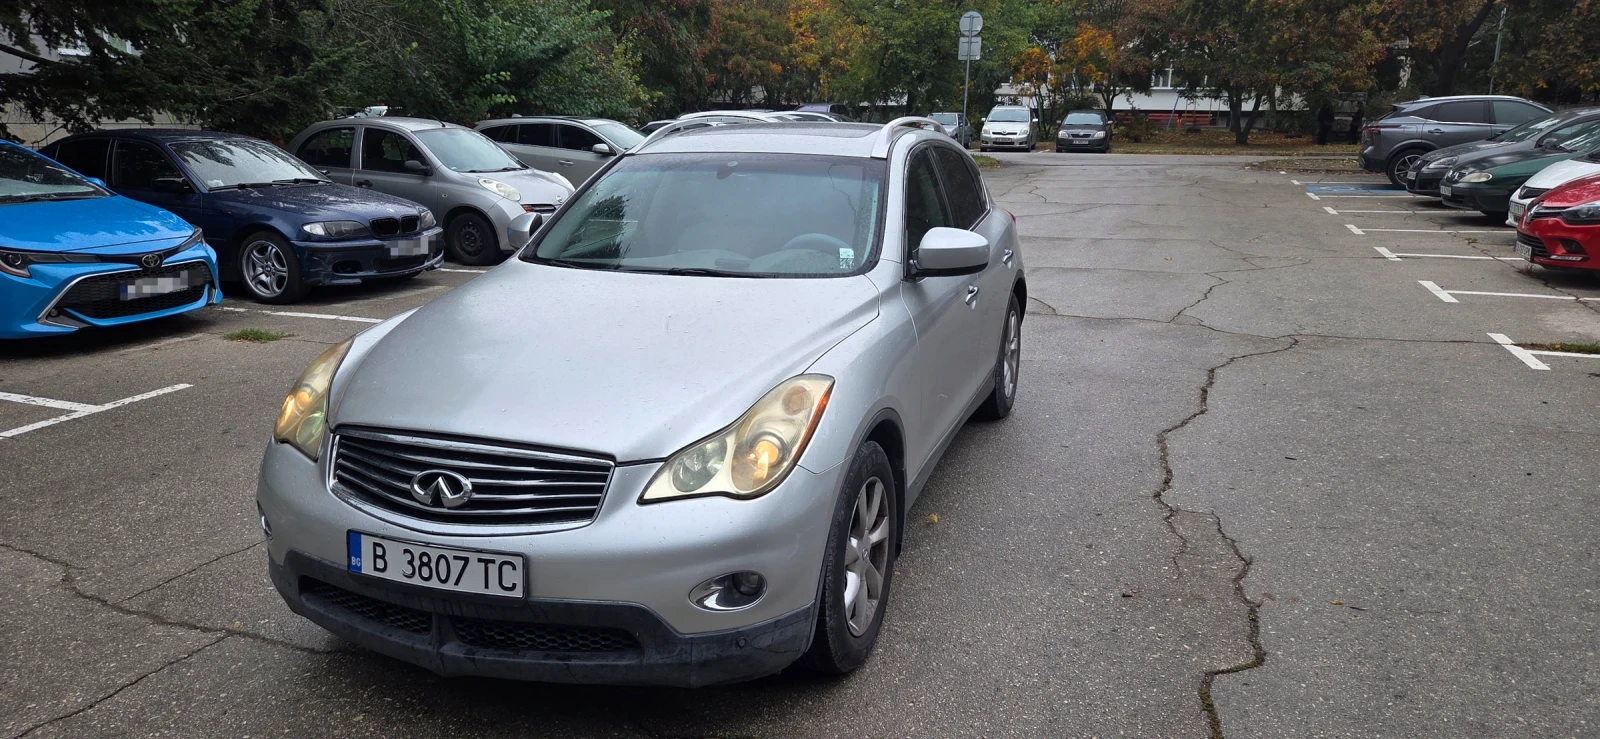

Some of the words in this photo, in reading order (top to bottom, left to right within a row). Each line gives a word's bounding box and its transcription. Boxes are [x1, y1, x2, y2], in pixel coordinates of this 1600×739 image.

[351, 556, 361, 567] BG
[372, 541, 388, 573] B
[402, 548, 470, 586] 3807
[477, 557, 517, 592] TC
